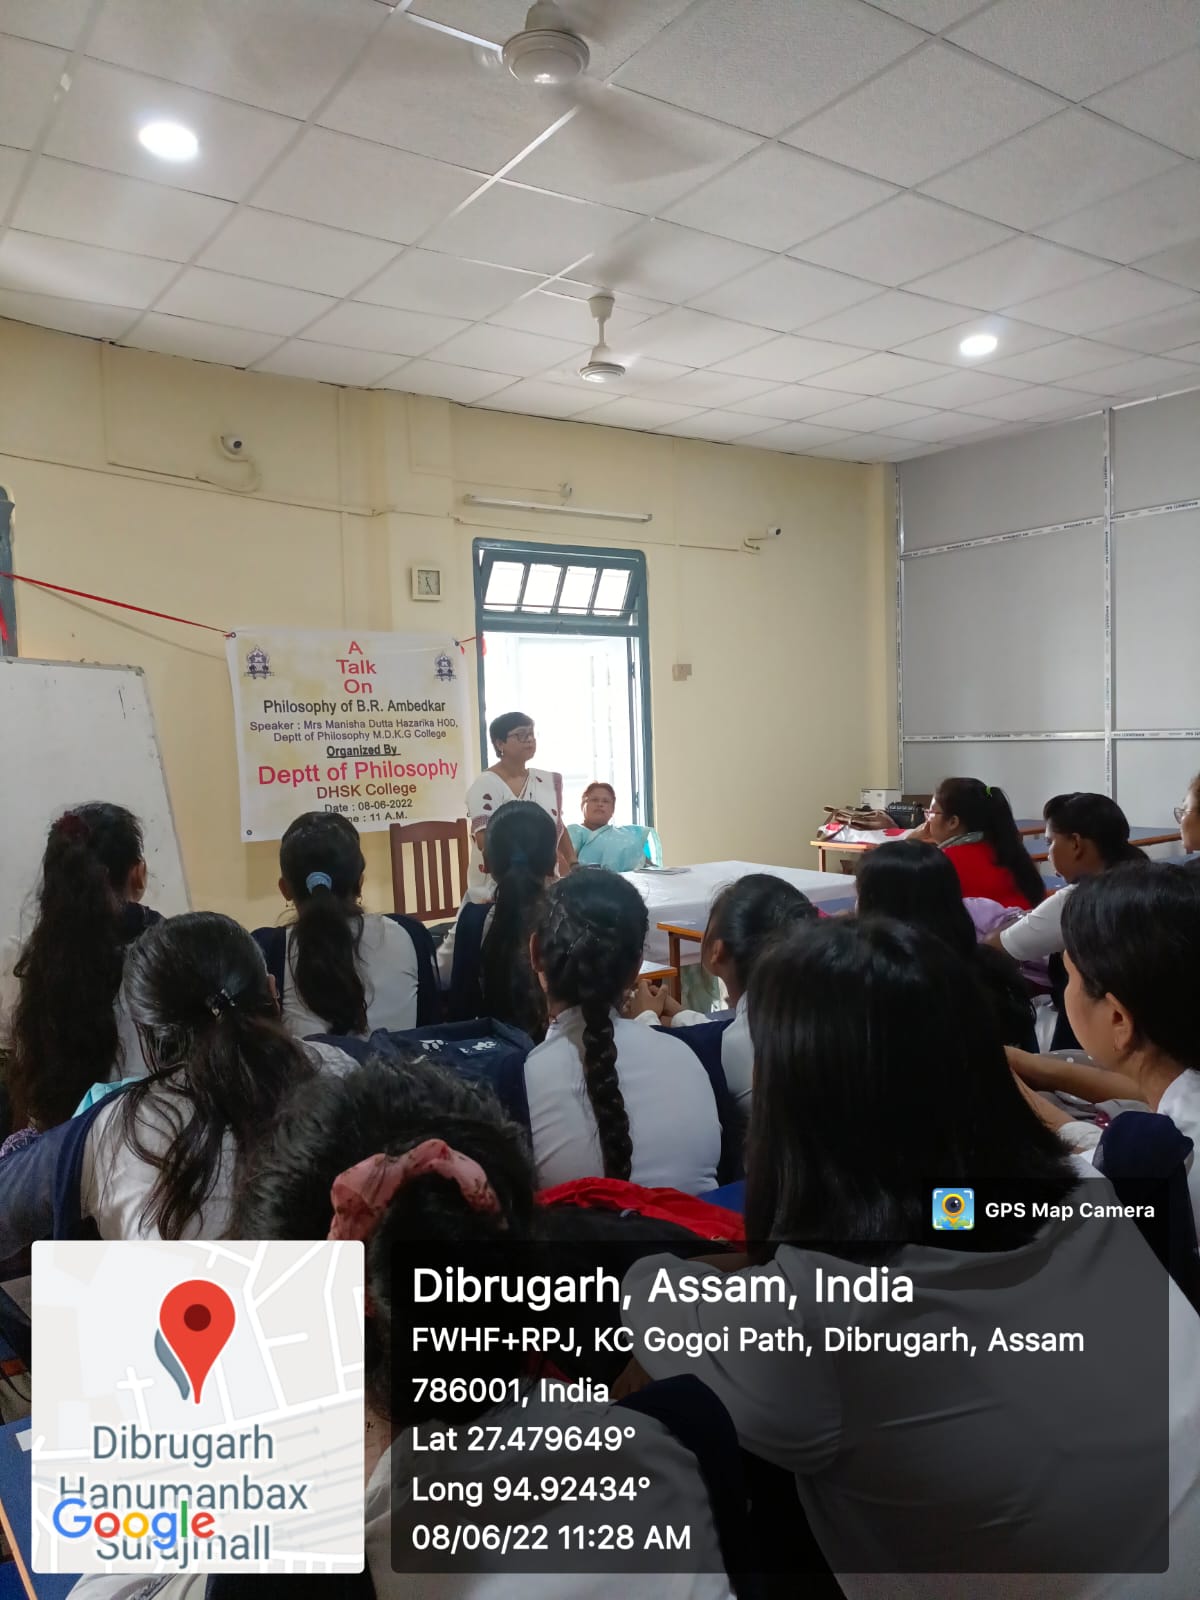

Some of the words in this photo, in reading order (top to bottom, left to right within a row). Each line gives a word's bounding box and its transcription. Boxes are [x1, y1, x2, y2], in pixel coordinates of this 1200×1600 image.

[348, 641, 364, 655] A
[336, 659, 377, 675] Talk
[344, 679, 373, 694] On
[263, 699, 337, 716] Philosophy
[341, 699, 353, 713] of
[357, 699, 384, 712] B.R.
[387, 699, 446, 712] Ambedkar
[249, 720, 294, 733] Speaker
[303, 720, 322, 730] Mrs
[325, 719, 366, 729] Manisha
[368, 719, 394, 728] Dutta
[396, 718, 435, 727] Hazarika
[273, 732, 302, 743] Deptt
[304, 732, 315, 741] of
[317, 730, 370, 742] Philosophy
[373, 729, 412, 739] M.D.K.G
[414, 729, 447, 740] College
[326, 743, 381, 758] Organized
[383, 743, 397, 757] By
[258, 764, 321, 788] Deptt
[327, 762, 348, 781] of
[354, 758, 458, 780] Philosophy
[316, 784, 362, 799] DHSK
[365, 782, 417, 797] College
[324, 803, 349, 813] Date
[358, 798, 414, 811] 08-06-2022
[369, 813, 381, 822] 11
[384, 811, 408, 820] A.M.
